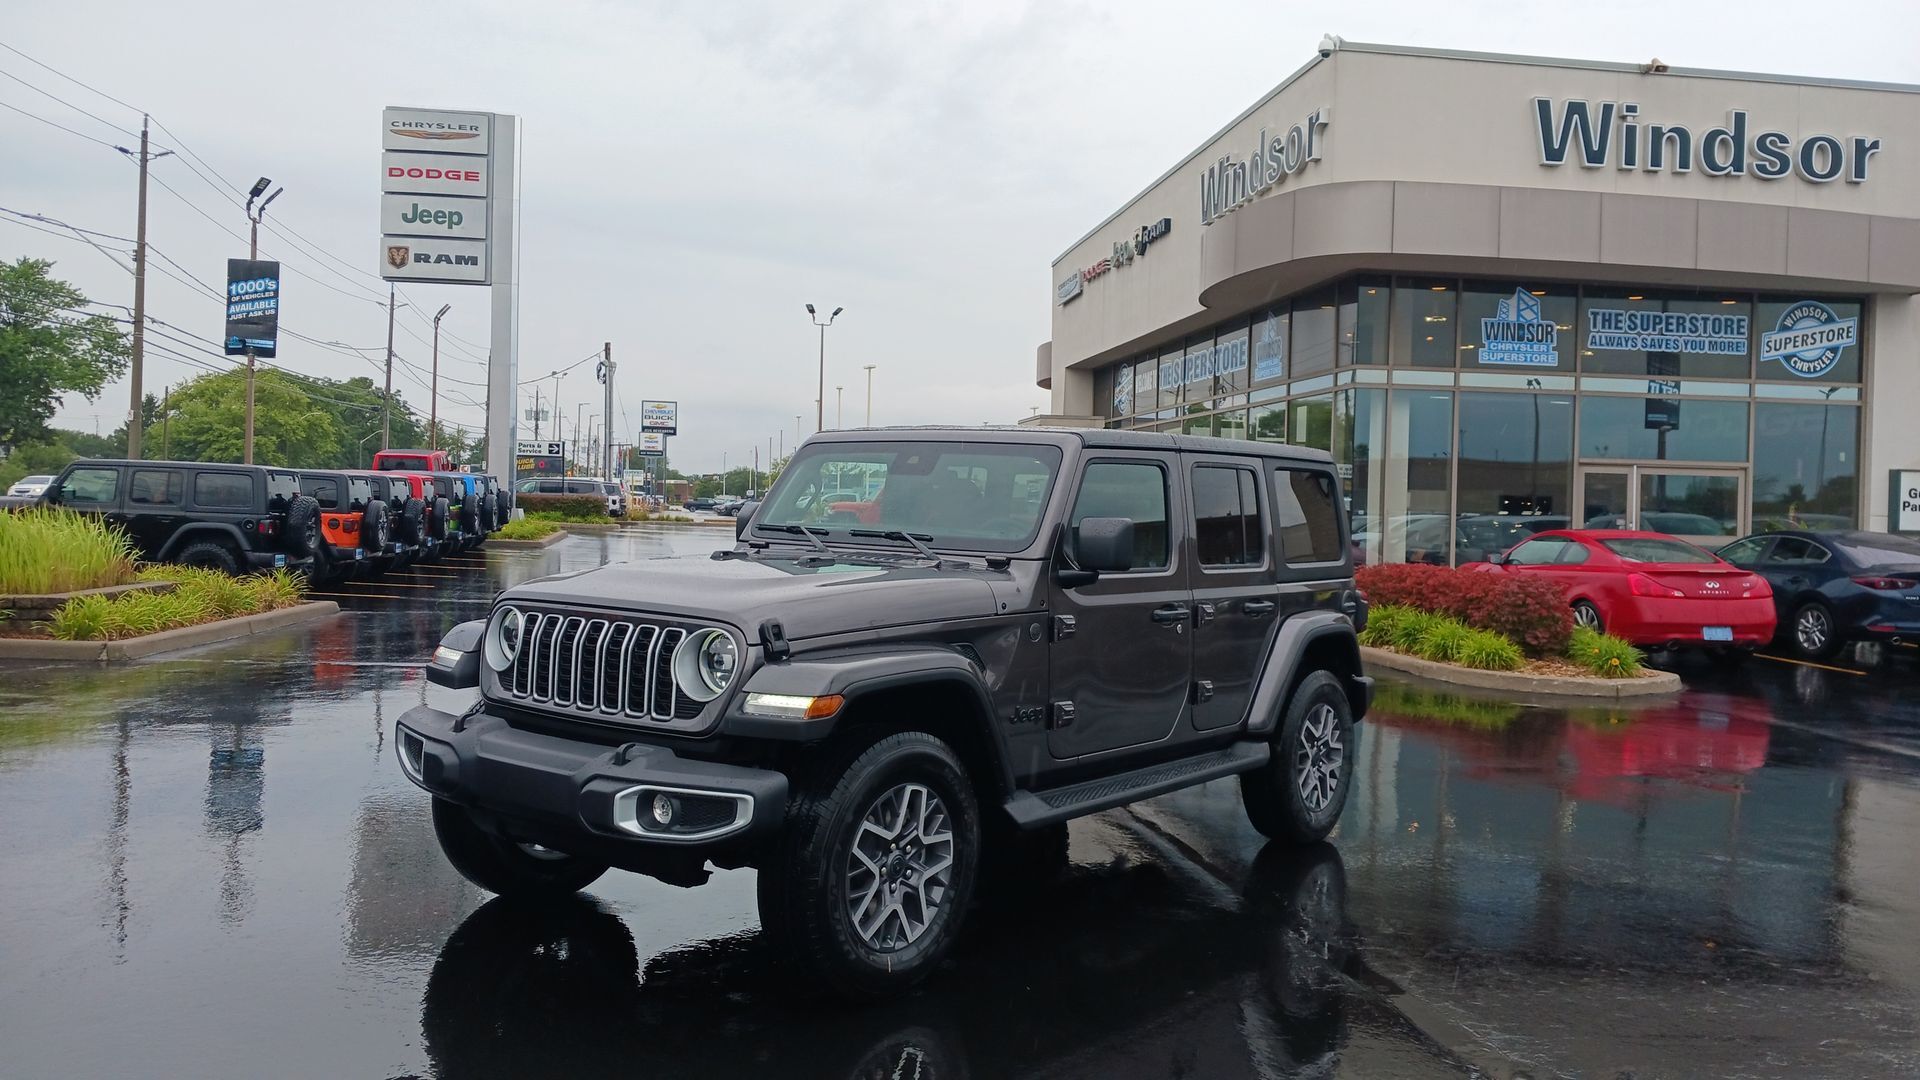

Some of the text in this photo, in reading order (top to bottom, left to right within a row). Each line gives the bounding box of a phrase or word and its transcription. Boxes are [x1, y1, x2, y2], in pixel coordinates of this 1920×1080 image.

[391, 120, 480, 132] CHRYSLER
[1533, 96, 1881, 184] Windsor
[388, 167, 480, 182] DODGE
[1200, 107, 1329, 226] Windsor
[402, 203, 463, 229] Jeep
[1142, 217, 1172, 244] RAM
[413, 252, 479, 266] RAM
[229, 279, 277, 296] 1000's
[241, 291, 275, 301] VEHICLES
[229, 299, 276, 314] AVAILABLE
[229, 308, 276, 320] JUST ASK US
[1590, 311, 1747, 337] THE SUPERSTORE
[1784, 306, 1829, 328] WINDSOR
[1484, 321, 1555, 343] WINDSOR
[1765, 325, 1854, 354] SUPERSTORE
[1490, 342, 1548, 352] CHRYSLER
[1590, 334, 1746, 354] ALWAYS SAVES YOU MORE!
[1160, 364, 1173, 388] THE
[1173, 338, 1248, 387] SUPERSTORE
[1482, 351, 1557, 363] SUPERSTORE
[1790, 350, 1835, 373] CHRYSLER
[1010, 705, 1043, 725] Jeep
